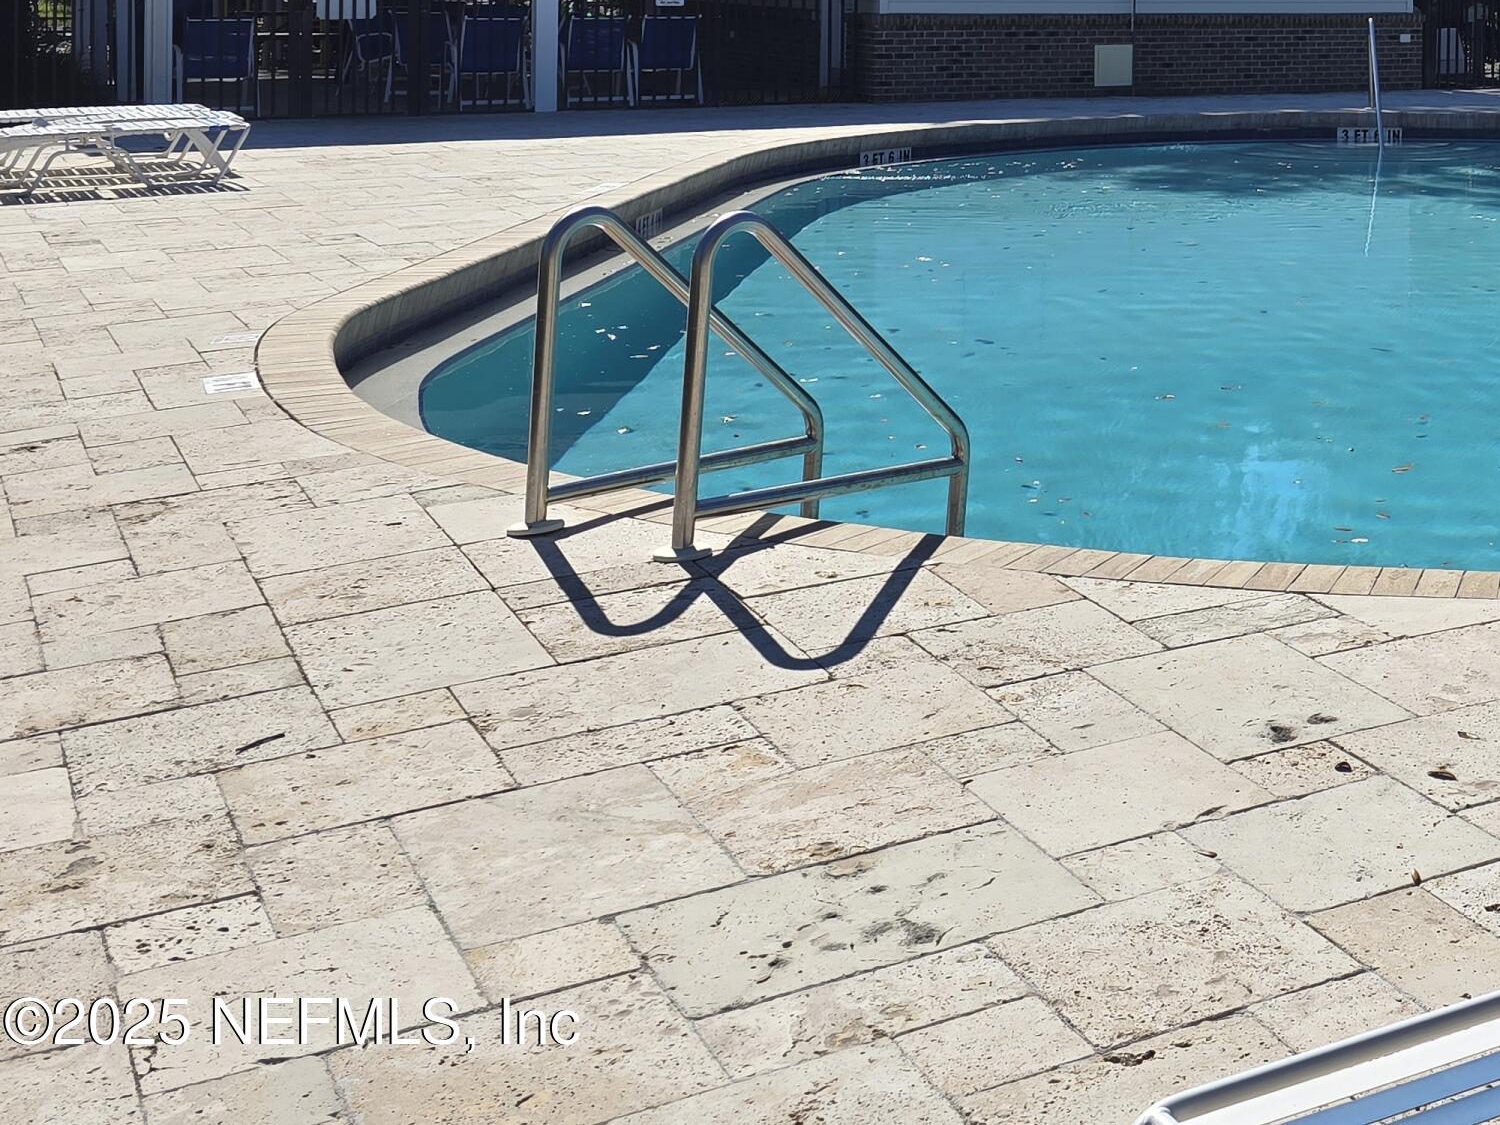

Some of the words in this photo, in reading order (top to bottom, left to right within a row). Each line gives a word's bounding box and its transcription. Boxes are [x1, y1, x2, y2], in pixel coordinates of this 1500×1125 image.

[1341, 129, 1349, 141] 3
[1355, 129, 1369, 143] FT
[1387, 129, 1401, 143] IN
[873, 152, 885, 165] FT
[888, 151, 895, 164] 6
[899, 148, 910, 162] IN
